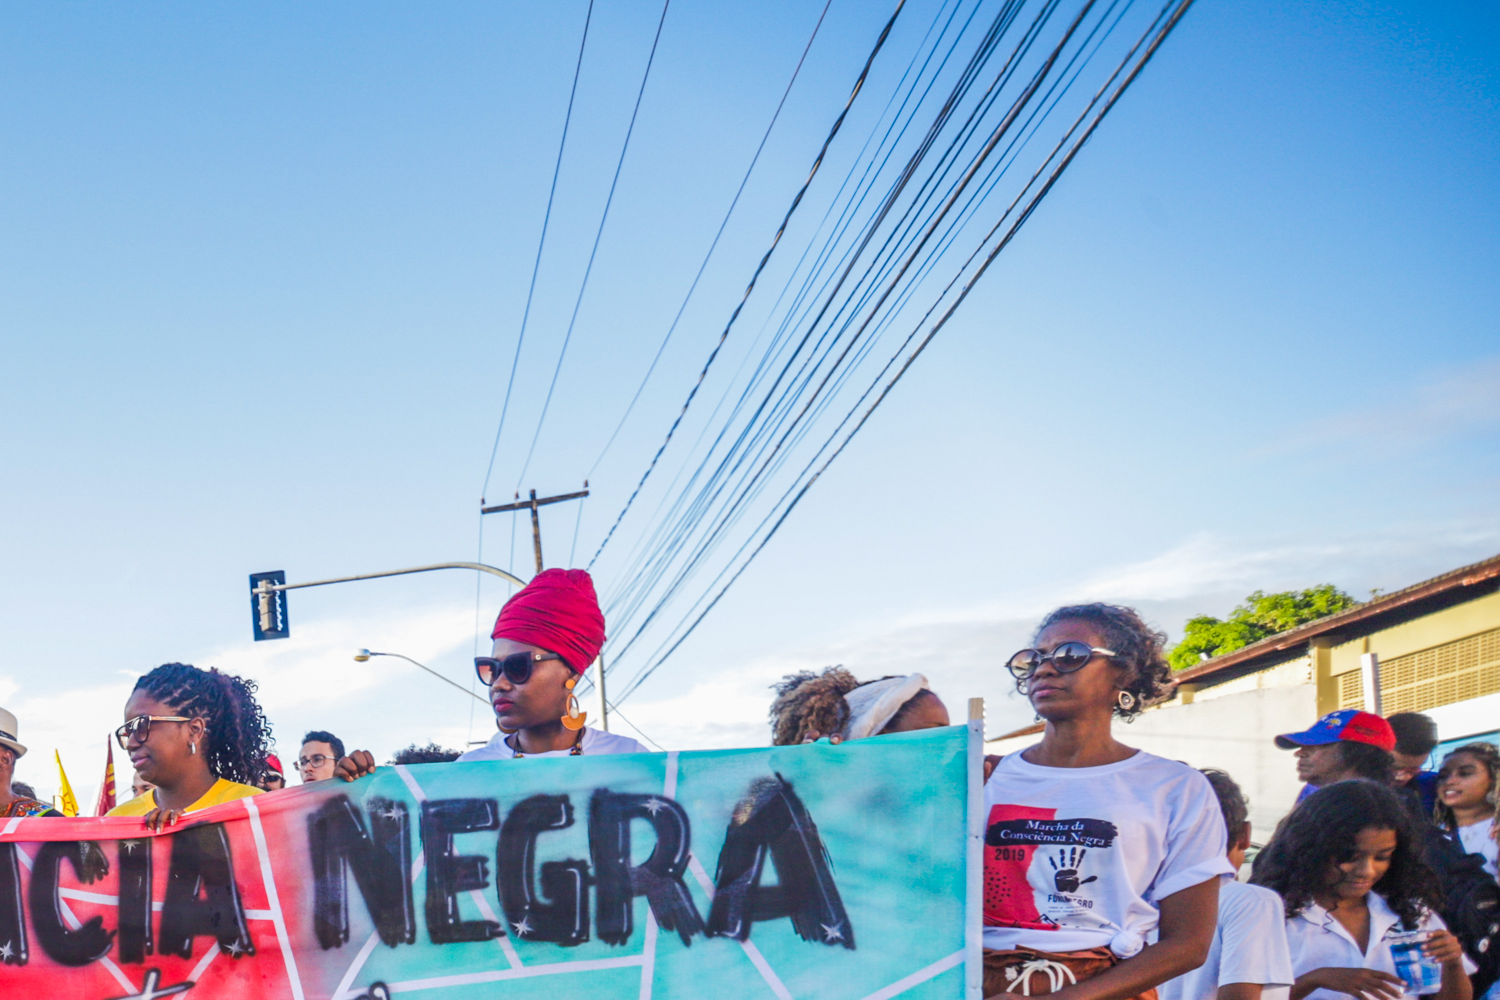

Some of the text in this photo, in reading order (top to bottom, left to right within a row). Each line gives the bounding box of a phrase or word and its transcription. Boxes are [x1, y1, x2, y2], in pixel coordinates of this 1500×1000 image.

[1025, 820, 1085, 832] Marcha da
[1000, 829, 1105, 848] Consciência Negra
[306, 771, 857, 951] NEGRA
[994, 847, 1025, 861] 2019
